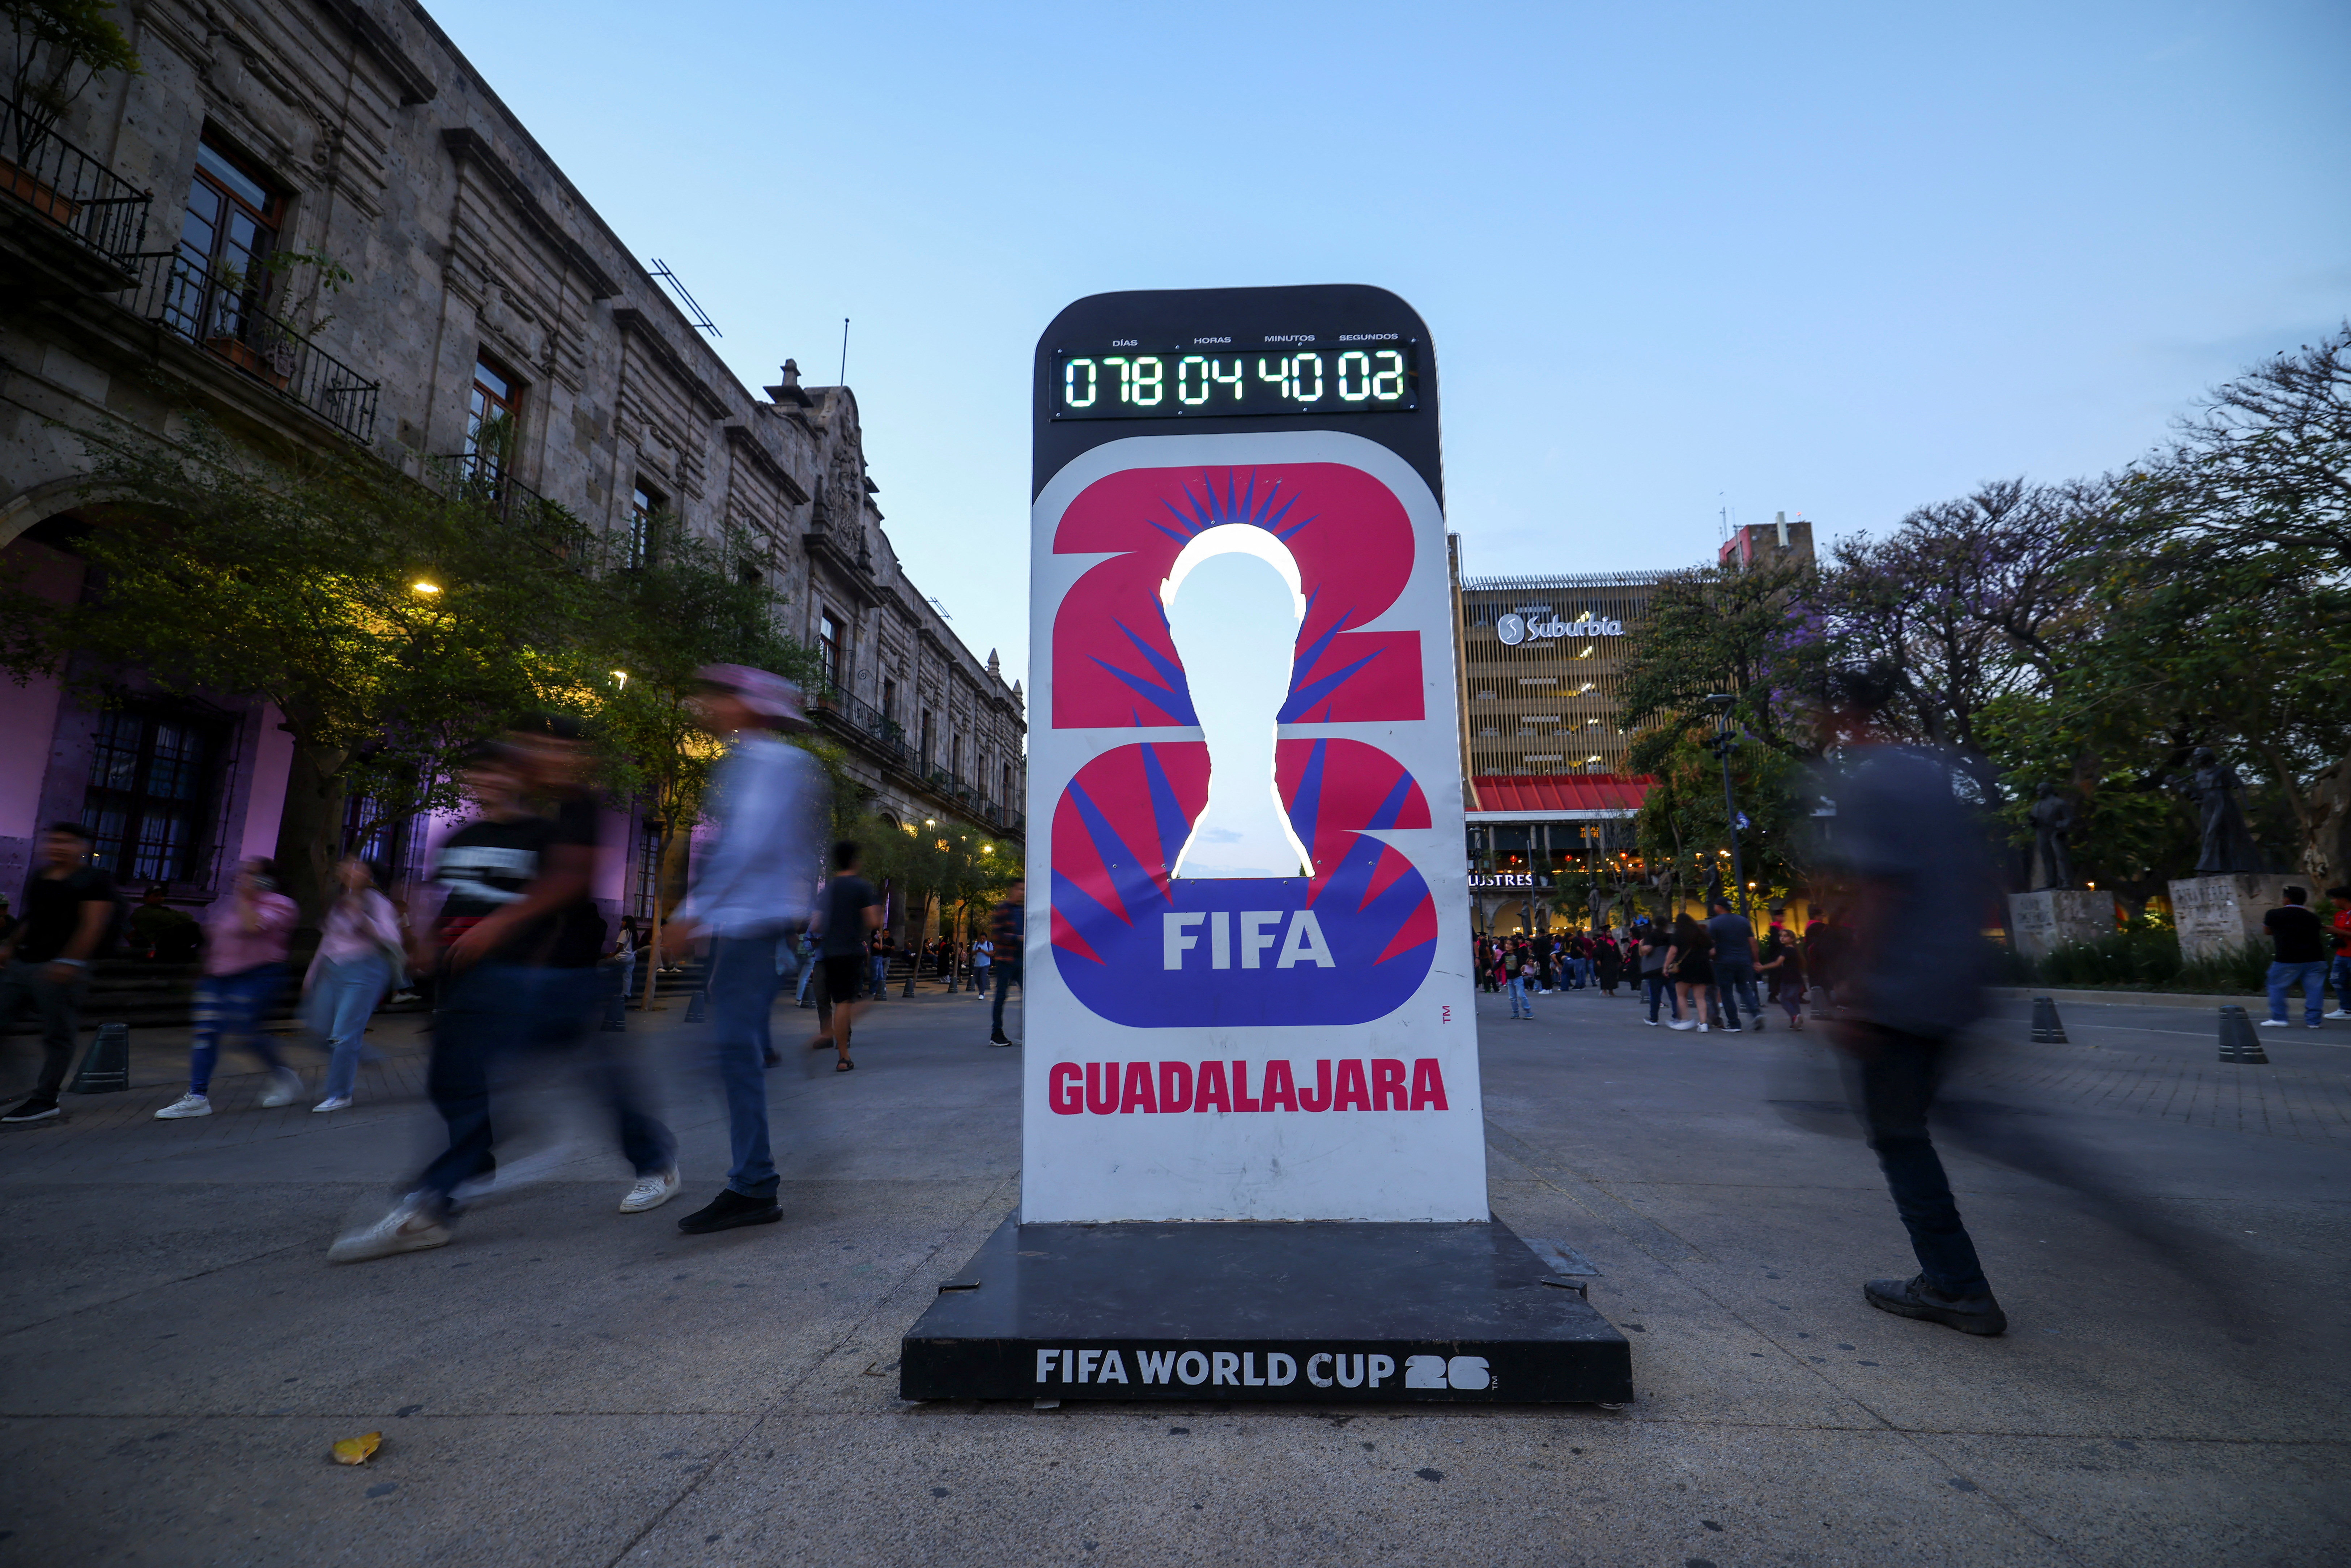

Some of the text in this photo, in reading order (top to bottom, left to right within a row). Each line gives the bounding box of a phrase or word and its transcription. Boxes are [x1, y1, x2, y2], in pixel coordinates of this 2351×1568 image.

[1112, 338, 1138, 347] DÍAS
[1065, 350, 1404, 408] 078 04 40 02
[1527, 614, 1625, 642] Suburbia
[1163, 910, 1336, 970] FIFA
[1049, 1058, 1449, 1115] GUADALAJARA
[1036, 1349, 1490, 1390] FIFA WORLD CUP 26
